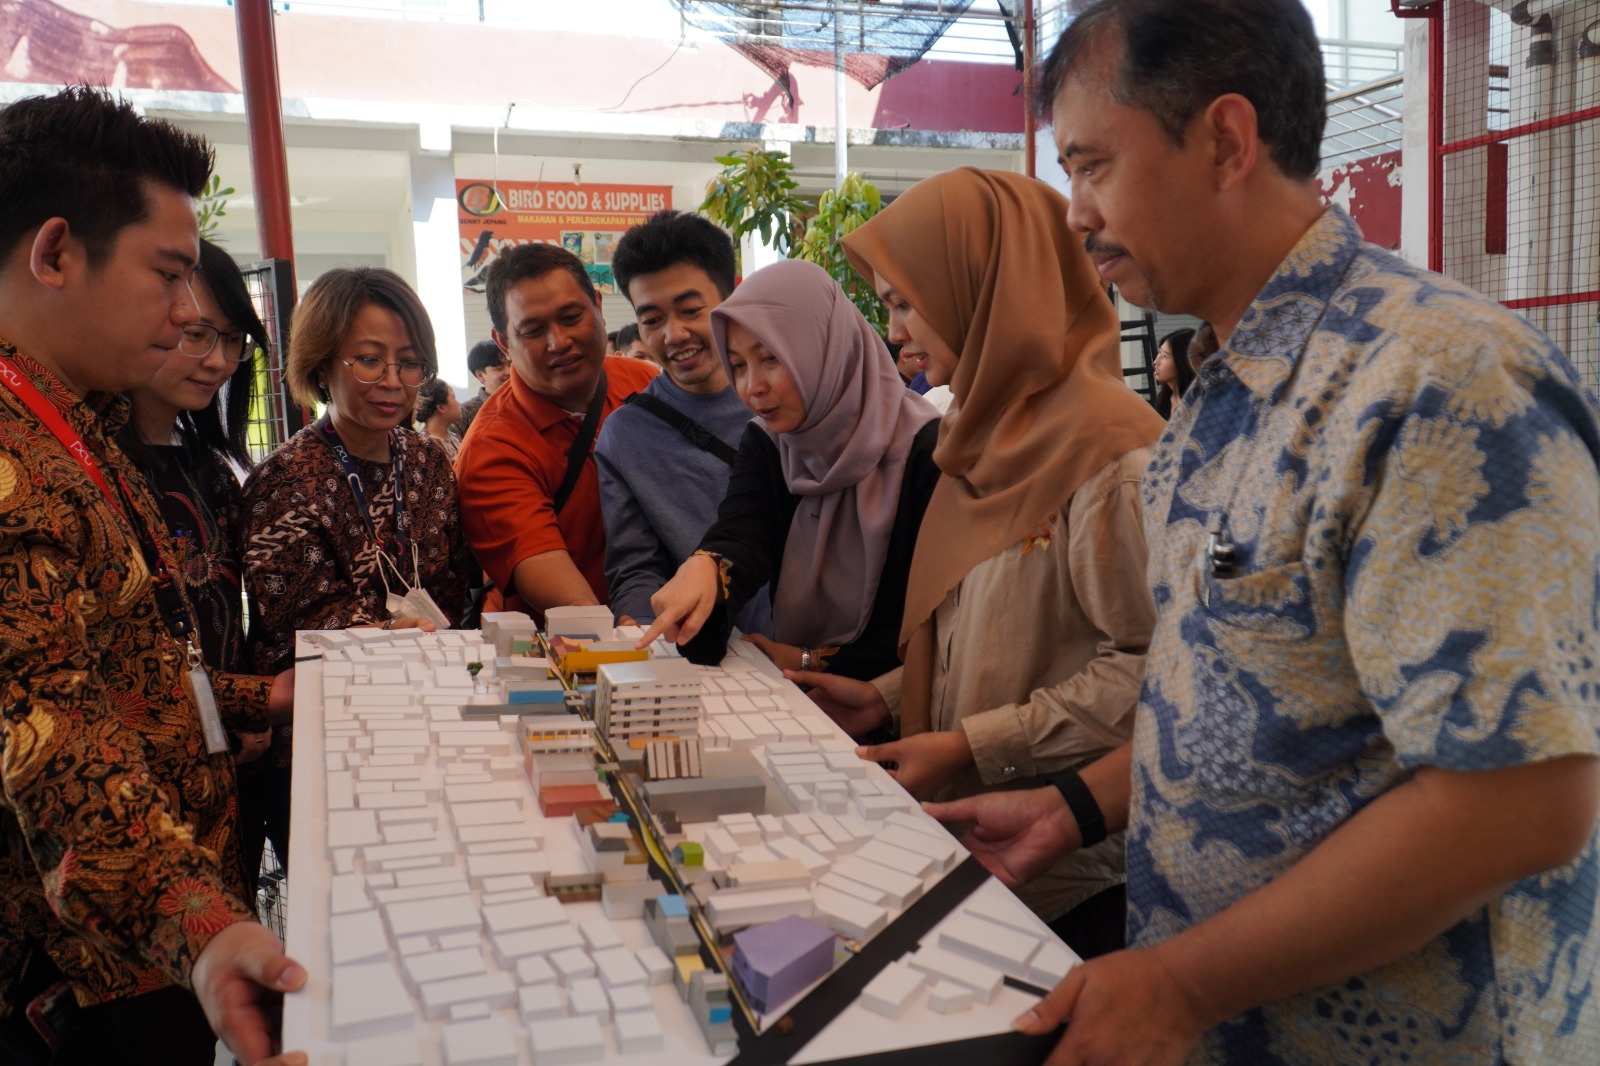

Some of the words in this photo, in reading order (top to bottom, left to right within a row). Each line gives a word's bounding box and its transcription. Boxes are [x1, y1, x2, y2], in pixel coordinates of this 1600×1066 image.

[508, 189, 543, 209] BIRD
[546, 190, 588, 210] FOOD
[591, 191, 602, 210] &
[604, 191, 665, 211] SUPPLIES
[517, 215, 556, 223] MAKANAN
[558, 215, 564, 223] &
[566, 216, 626, 225] PERLENGKAPAN
